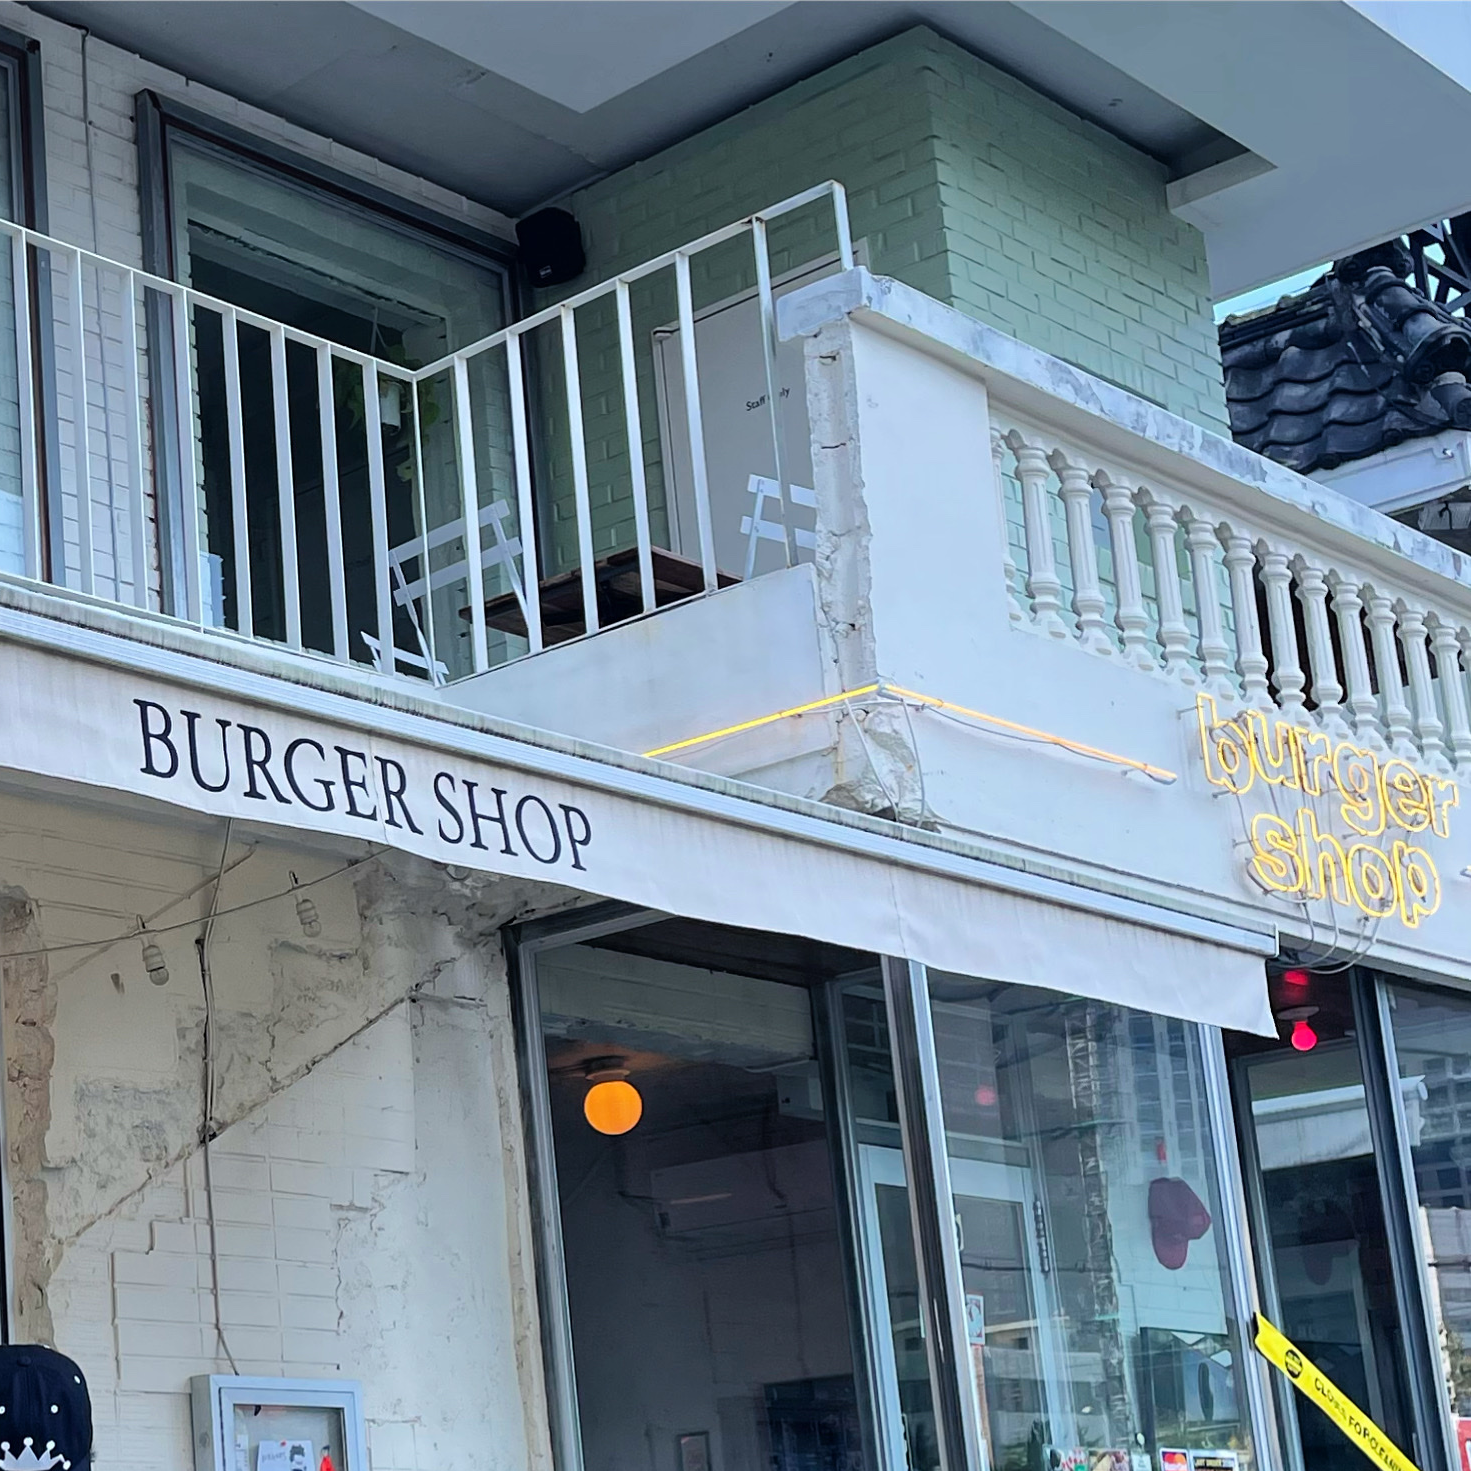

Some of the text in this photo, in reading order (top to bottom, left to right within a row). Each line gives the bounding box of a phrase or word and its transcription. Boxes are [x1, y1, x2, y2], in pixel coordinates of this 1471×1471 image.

[745, 387, 791, 412] Staff ly
[133, 698, 593, 872] BURGER SHOP
[1196, 692, 1460, 839] burger
[1250, 807, 1441, 930] shop
[1347, 1414, 1371, 1440] FOR
